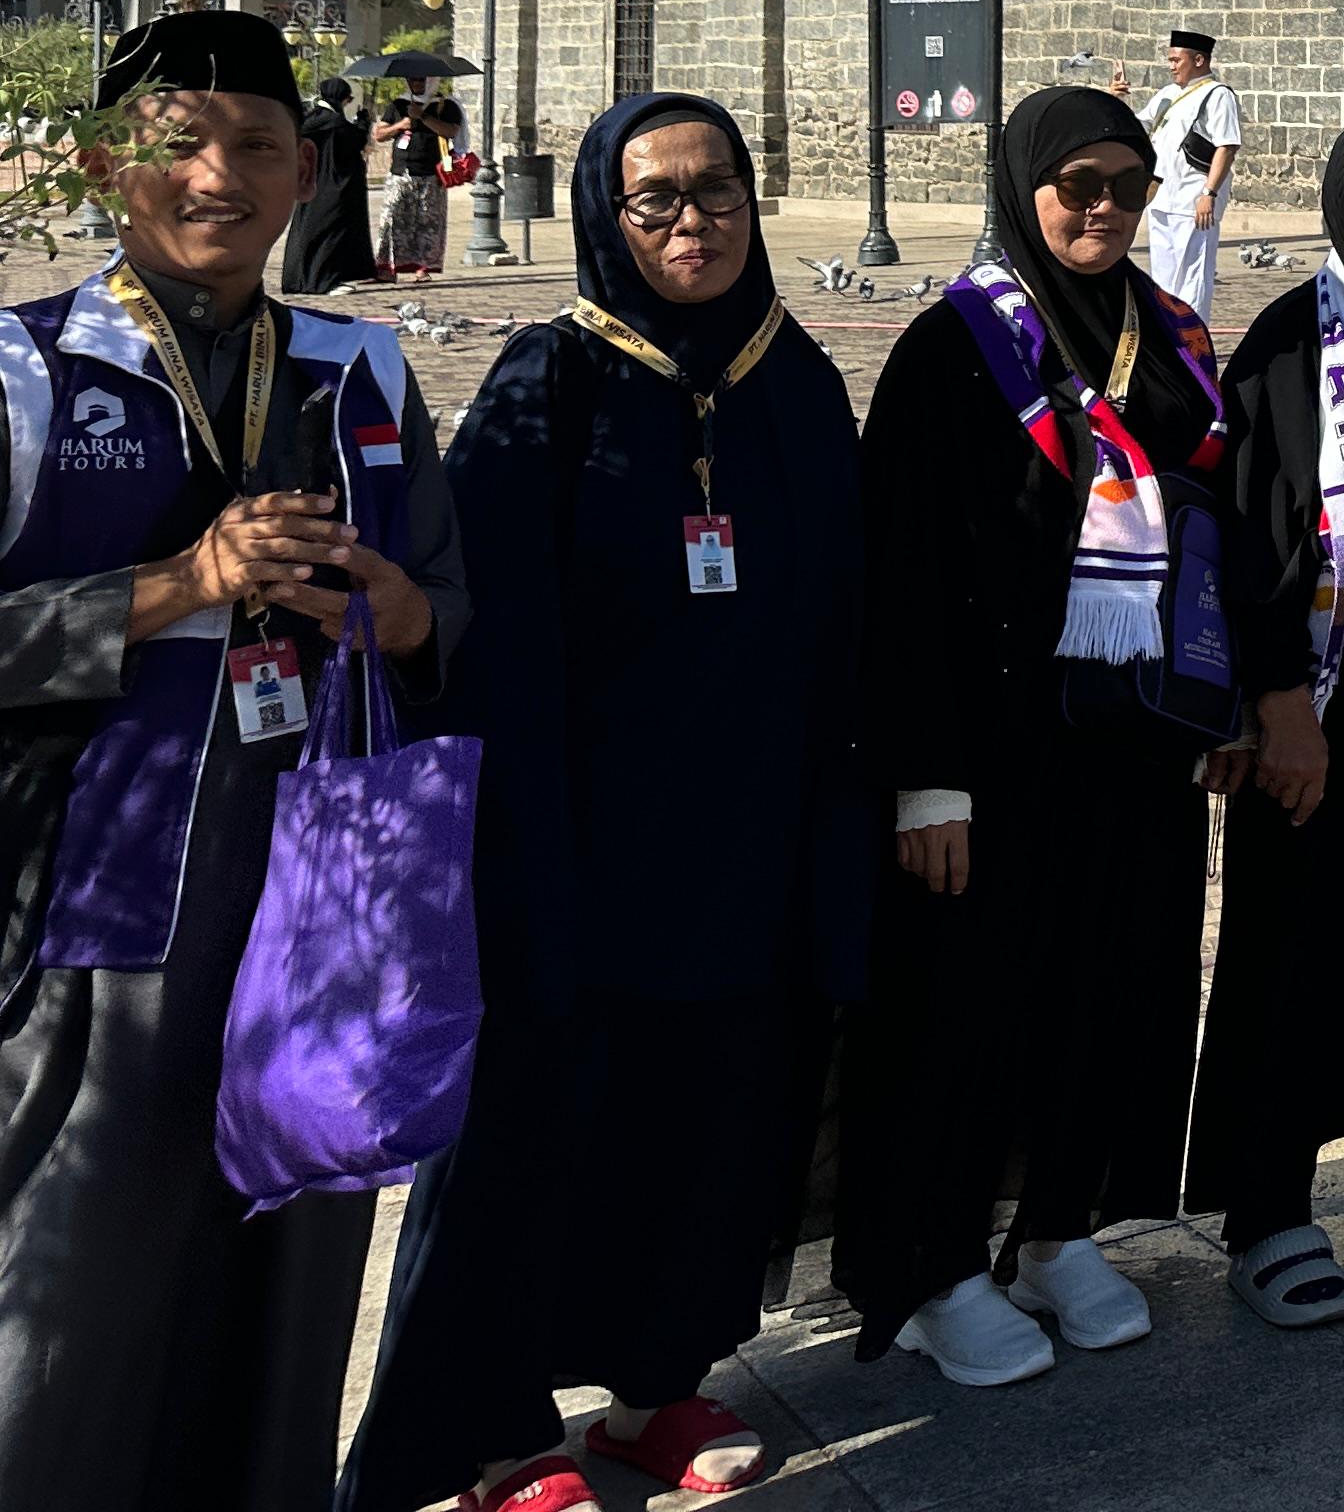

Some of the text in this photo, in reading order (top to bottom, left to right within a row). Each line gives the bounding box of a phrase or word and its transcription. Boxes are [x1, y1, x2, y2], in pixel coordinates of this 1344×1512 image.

[256, 335, 265, 360] BINA
[604, 319, 645, 351] WISATA
[135, 297, 167, 339] HARUM
[164, 341, 184, 373] BINA
[181, 375, 206, 426] WISATA
[252, 361, 265, 406] HARUM
[60, 438, 145, 458] HARUM
[58, 456, 145, 471] TOURS
